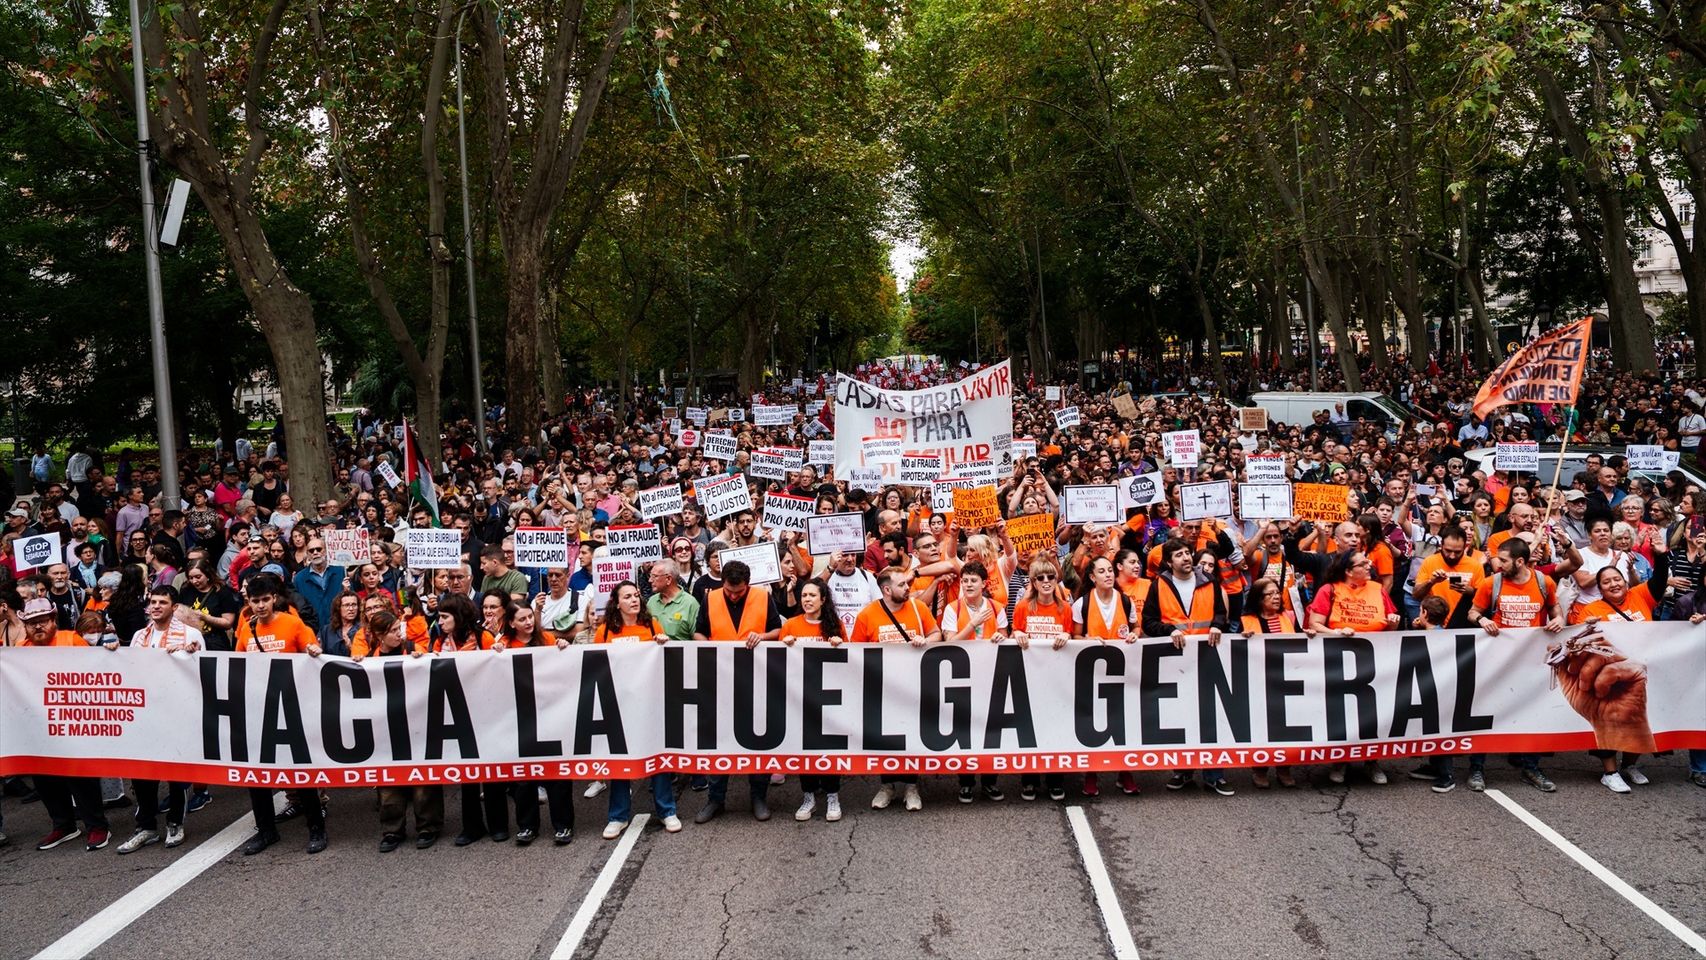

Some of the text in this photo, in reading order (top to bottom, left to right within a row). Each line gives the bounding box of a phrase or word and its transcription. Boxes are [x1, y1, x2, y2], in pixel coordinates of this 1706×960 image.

[837, 366, 1010, 416] CASAS PARA VIVIR
[875, 410, 972, 443] NO PARA
[707, 436, 737, 448] DERECHO
[712, 445, 735, 455] TECHO
[785, 449, 802, 458] FRAUDE
[1628, 448, 1662, 458] Nos multan
[765, 456, 784, 466] FRAUDE
[901, 458, 910, 468] NO
[917, 458, 940, 468] FRAUDE
[953, 462, 968, 471] ¡NOS
[751, 465, 784, 476] HIPOTECARIO!
[704, 478, 743, 503] ¡PEDIMOS
[1131, 481, 1153, 492] STOP
[641, 487, 680, 503] NO al FRAUDE
[643, 499, 683, 517] HIPOTECARIO!
[706, 493, 749, 517] LO JUSTO!
[766, 496, 814, 513] ACAMPADA
[933, 499, 945, 509] LO
[1296, 501, 1341, 512] ESTAS CASAS
[764, 512, 783, 526] PRO
[1298, 510, 1347, 522] SON NUESTRAS
[354, 529, 368, 540] NO
[427, 532, 434, 543] SU
[435, 532, 460, 543] BURBUJA
[516, 532, 565, 544] NO al FRAUDE
[608, 529, 659, 543] NO al FRAUDE
[25, 542, 48, 553] STOP
[427, 547, 437, 557] QUE
[610, 545, 661, 558] HIPOTECARIO!
[517, 550, 566, 562] HIPOTECARIO!
[596, 561, 632, 573] POR UNA
[600, 572, 630, 583] HUELGA
[47, 672, 122, 686] SINDICATO
[48, 691, 143, 706] DE INQUILINAS
[199, 634, 1494, 765] HACIA LA HUELGA GENERAL
[48, 708, 134, 723] E INQUILINOS
[48, 724, 122, 737] DE MADRID
[228, 769, 330, 784] BAJADA
[343, 768, 395, 784] DEL
[407, 764, 545, 783] ALQUILER
[558, 762, 610, 776] 50%
[645, 753, 852, 773] EXPROPIACIÓN
[867, 757, 979, 771] FONDOS
[993, 754, 1090, 769] BUITRE
[1124, 750, 1287, 767] CONTRATOS
[1300, 737, 1473, 761] INDEFINIDOS
